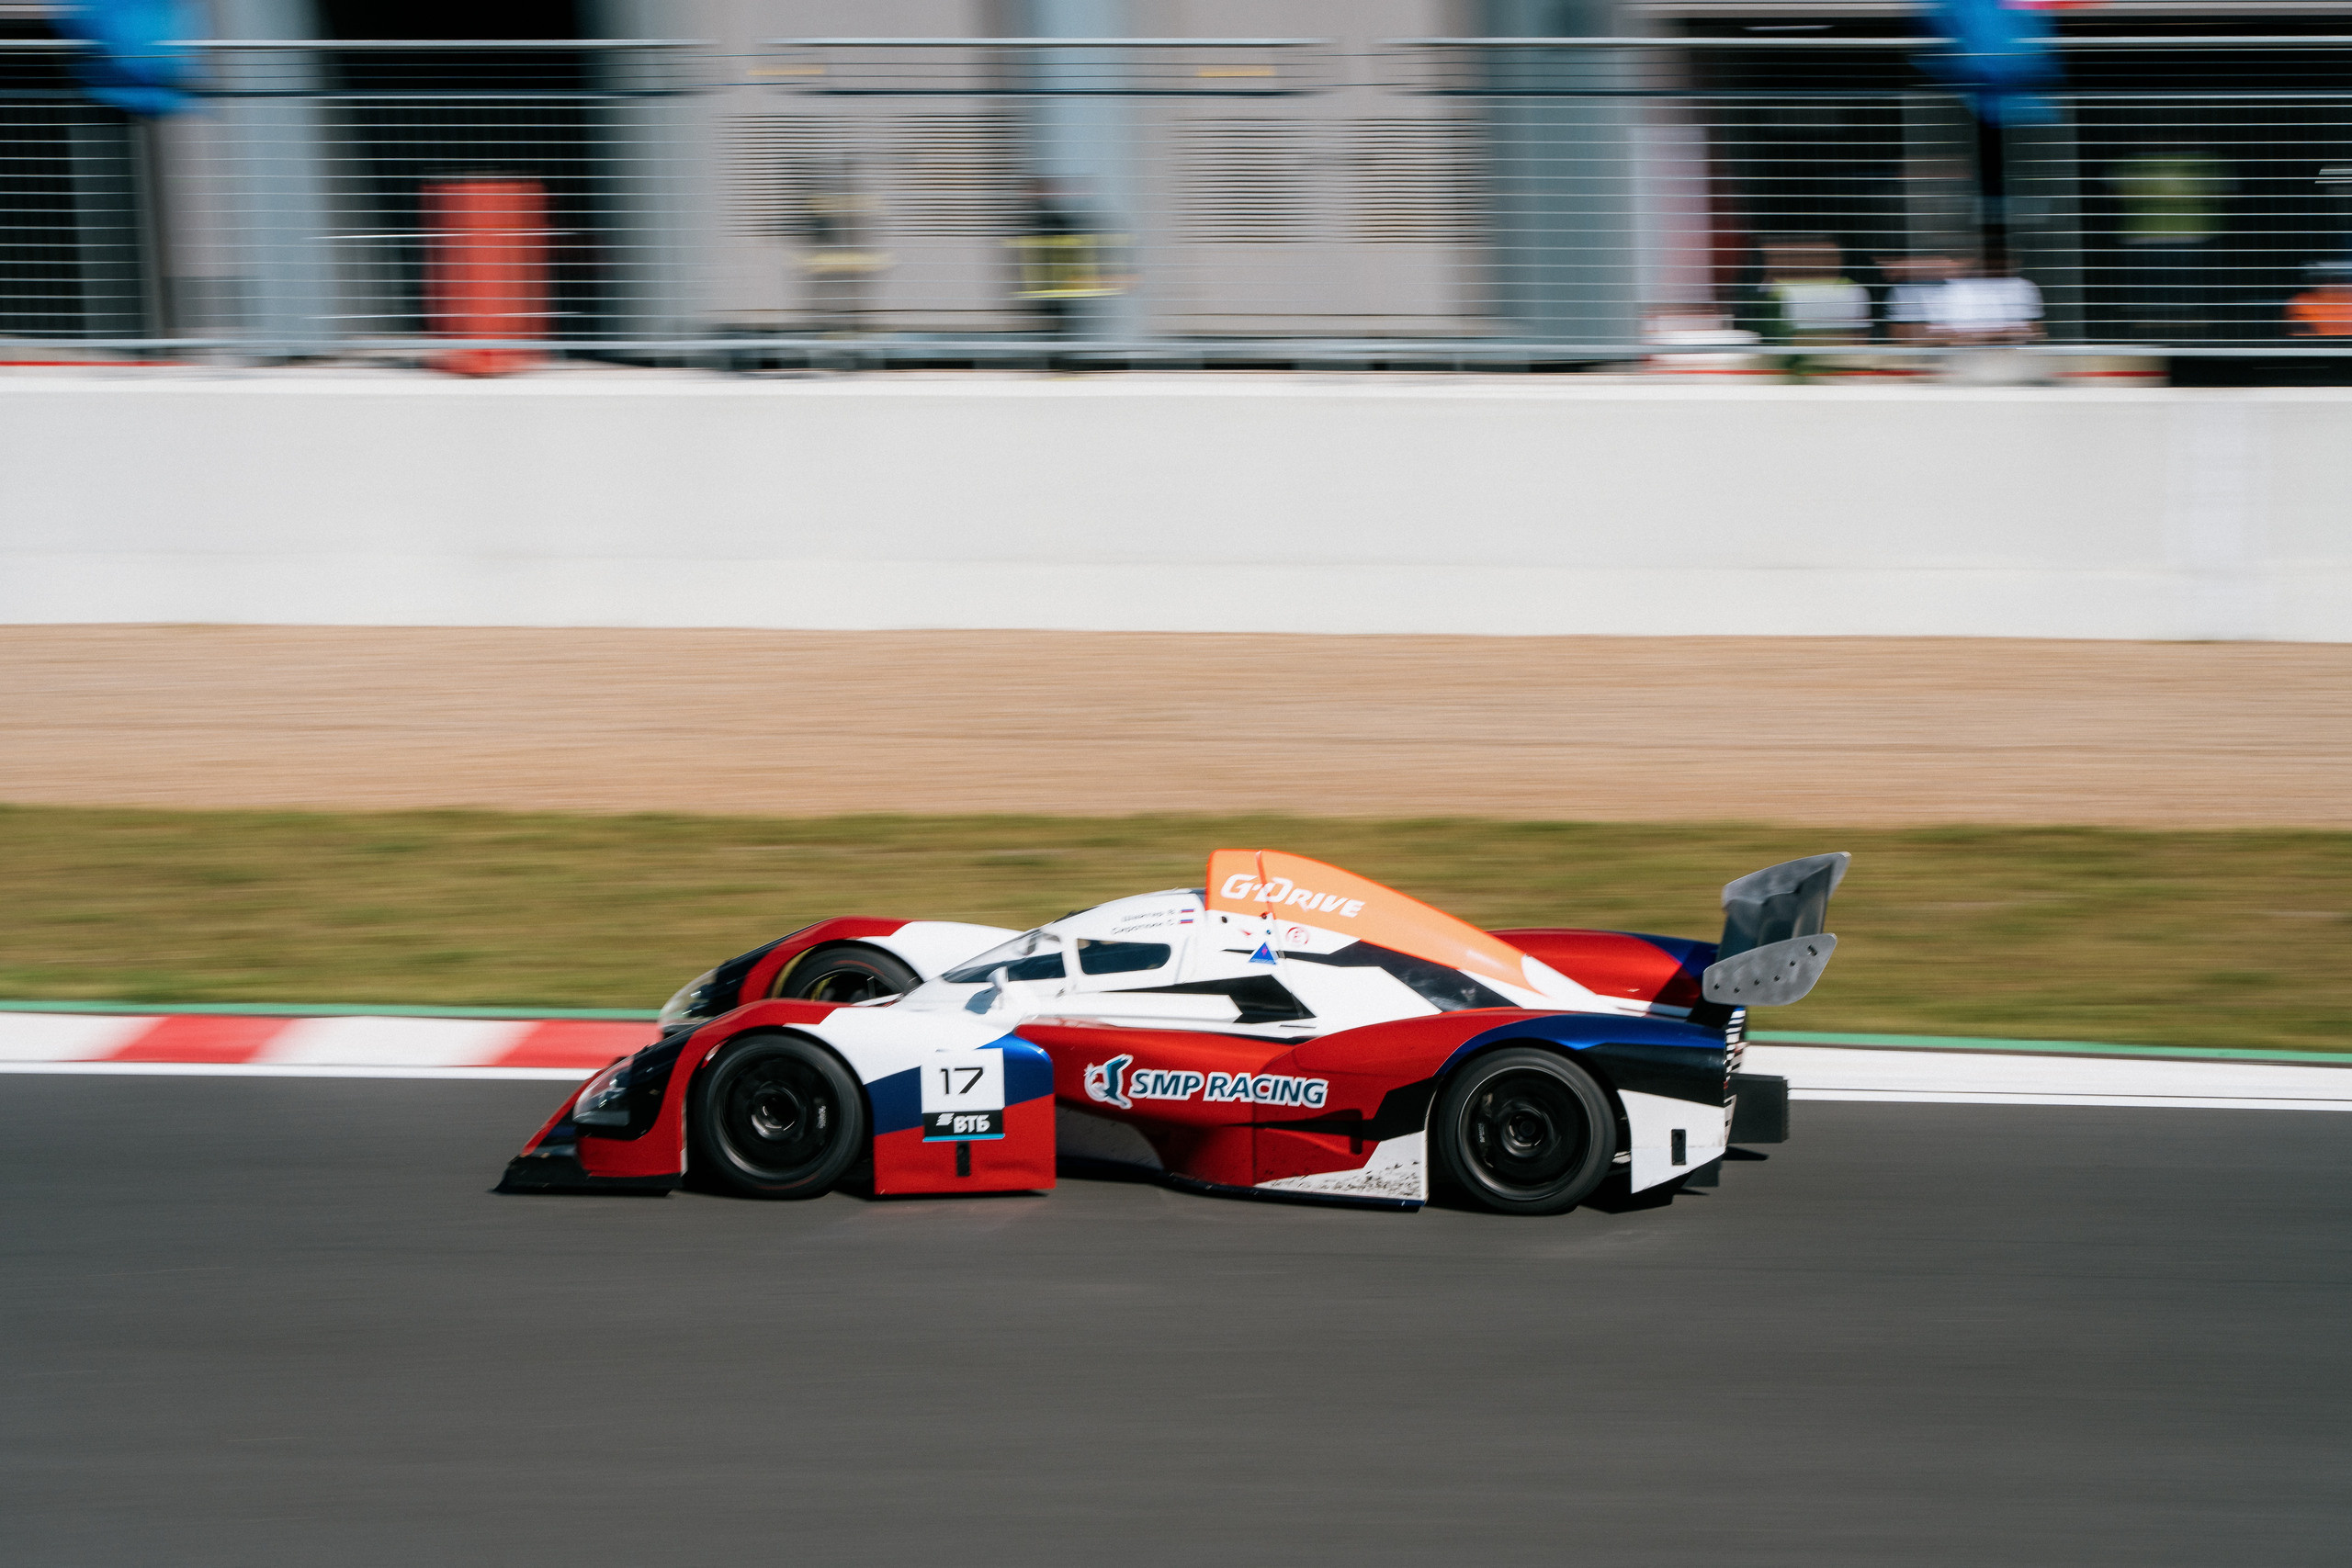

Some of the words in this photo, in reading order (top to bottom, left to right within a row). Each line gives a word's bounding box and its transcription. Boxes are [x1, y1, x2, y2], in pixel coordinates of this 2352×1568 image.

[940, 1067, 983, 1095] 17
[1130, 1069, 1203, 1100] SMP
[1204, 1072, 1328, 1107] RACING
[953, 1114, 990, 1134] ВТБ
